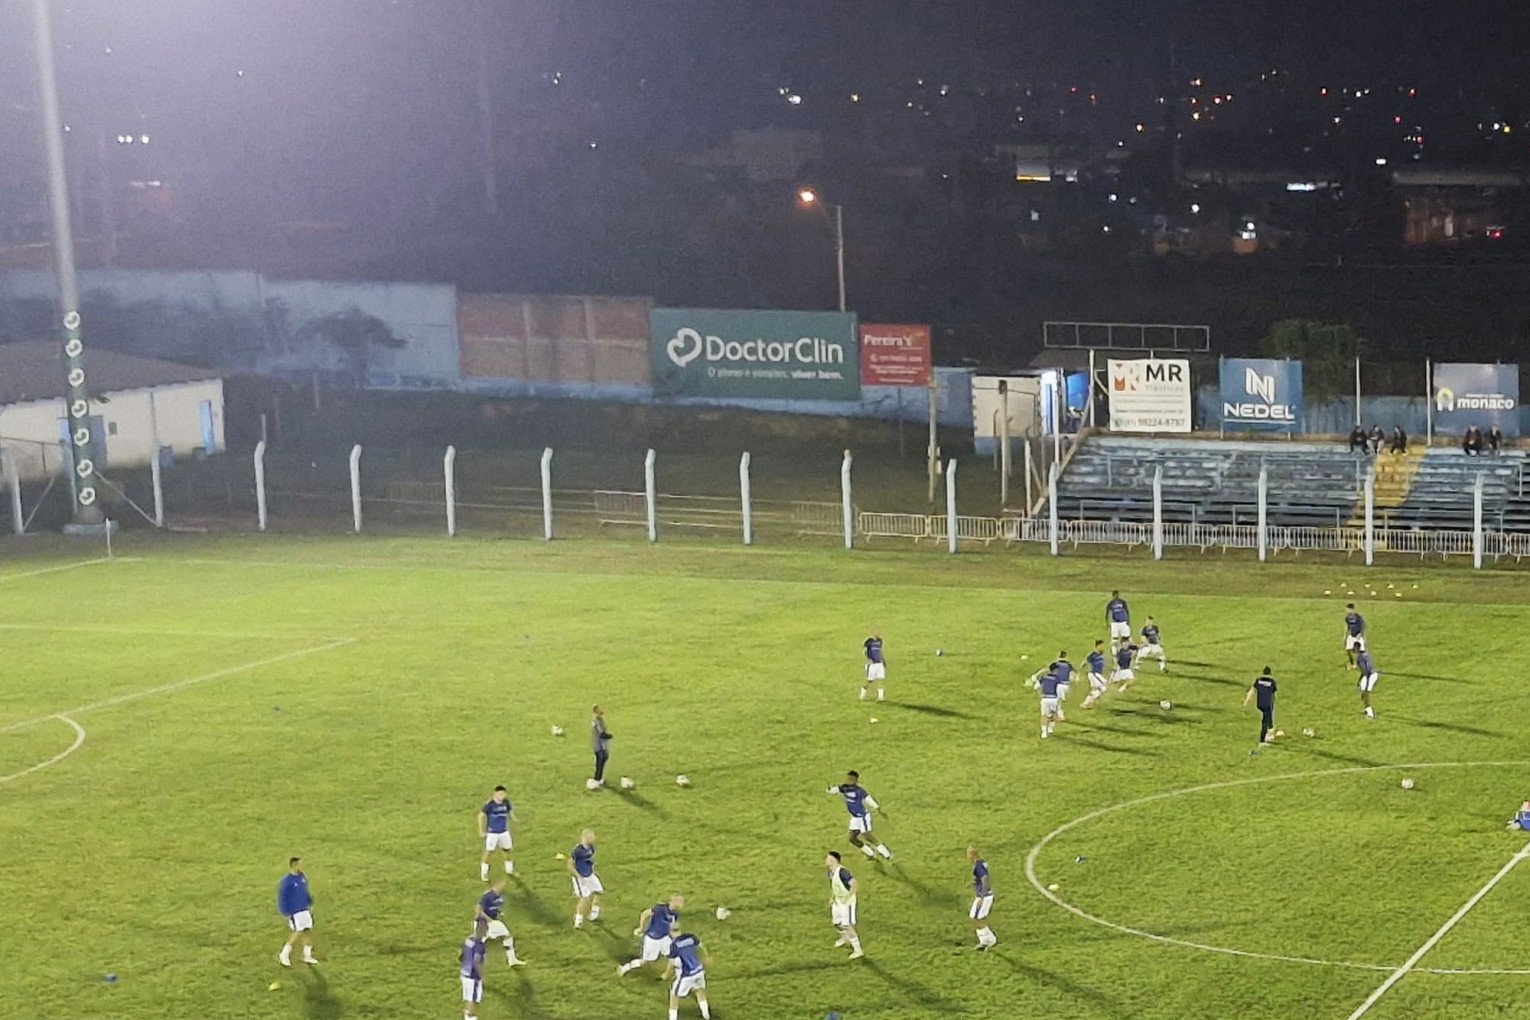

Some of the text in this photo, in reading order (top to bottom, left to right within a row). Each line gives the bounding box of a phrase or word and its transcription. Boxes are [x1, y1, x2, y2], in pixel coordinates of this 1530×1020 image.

[705, 335, 844, 363] DoctorClin
[1146, 364, 1182, 382] MR
[1223, 402, 1295, 420] NEDEL
[1457, 398, 1514, 410] monaco
